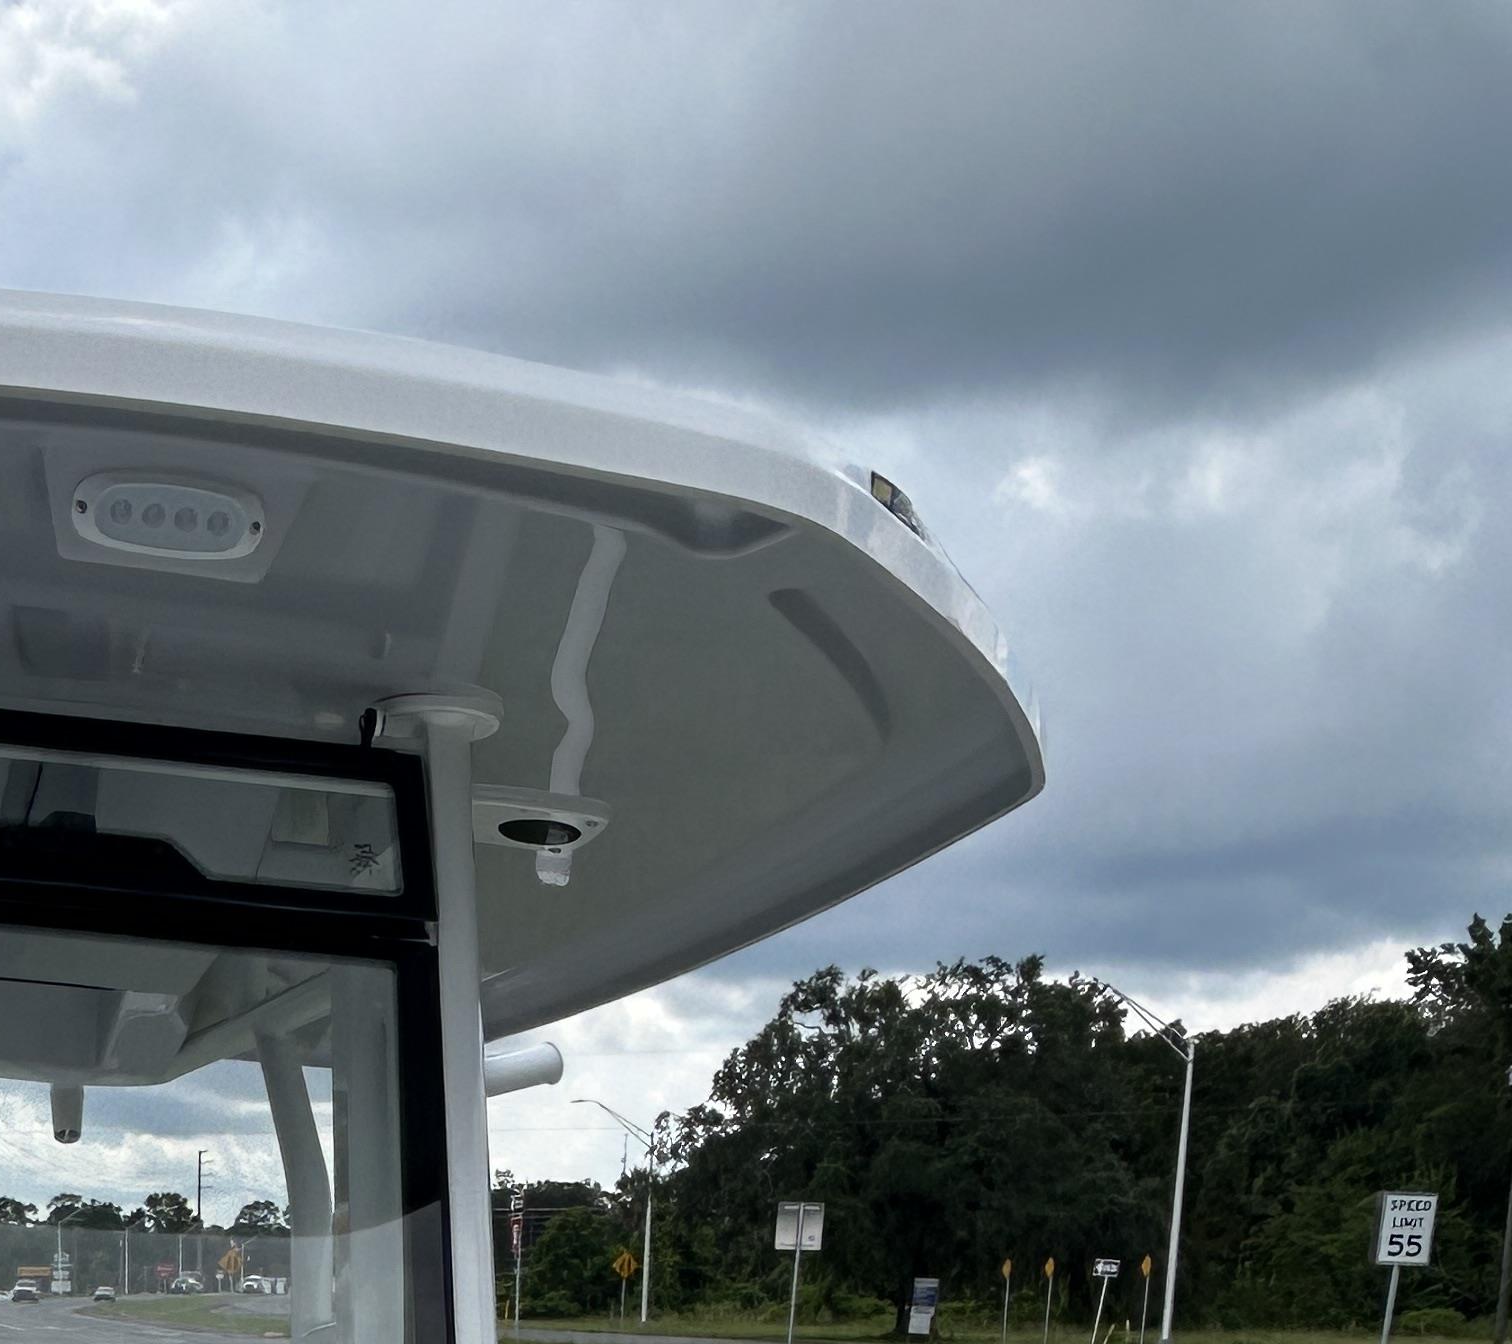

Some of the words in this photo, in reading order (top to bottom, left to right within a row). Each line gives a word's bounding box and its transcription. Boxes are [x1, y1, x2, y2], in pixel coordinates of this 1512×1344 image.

[1391, 1200, 1432, 1211] SPEED
[1393, 1217, 1424, 1228] LIMIT
[1387, 1234, 1422, 1256] 55
